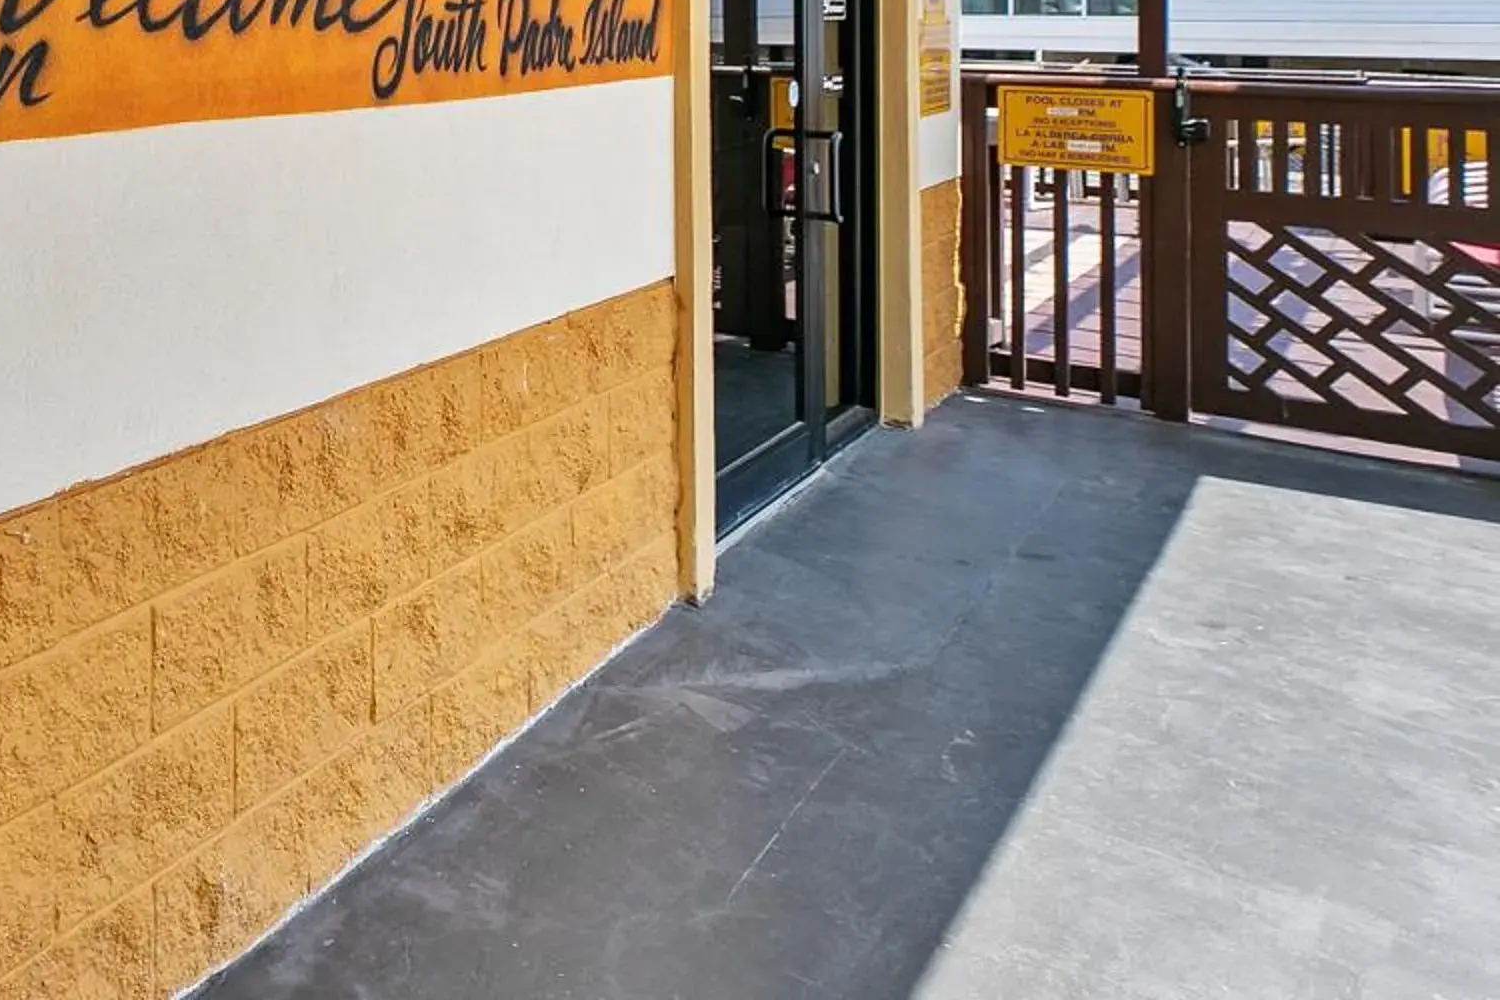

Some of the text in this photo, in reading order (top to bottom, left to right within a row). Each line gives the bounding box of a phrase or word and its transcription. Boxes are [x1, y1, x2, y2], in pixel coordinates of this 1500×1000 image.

[1026, 95, 1123, 108] POOL CLOSES AT
[1016, 128, 1030, 137] LA
